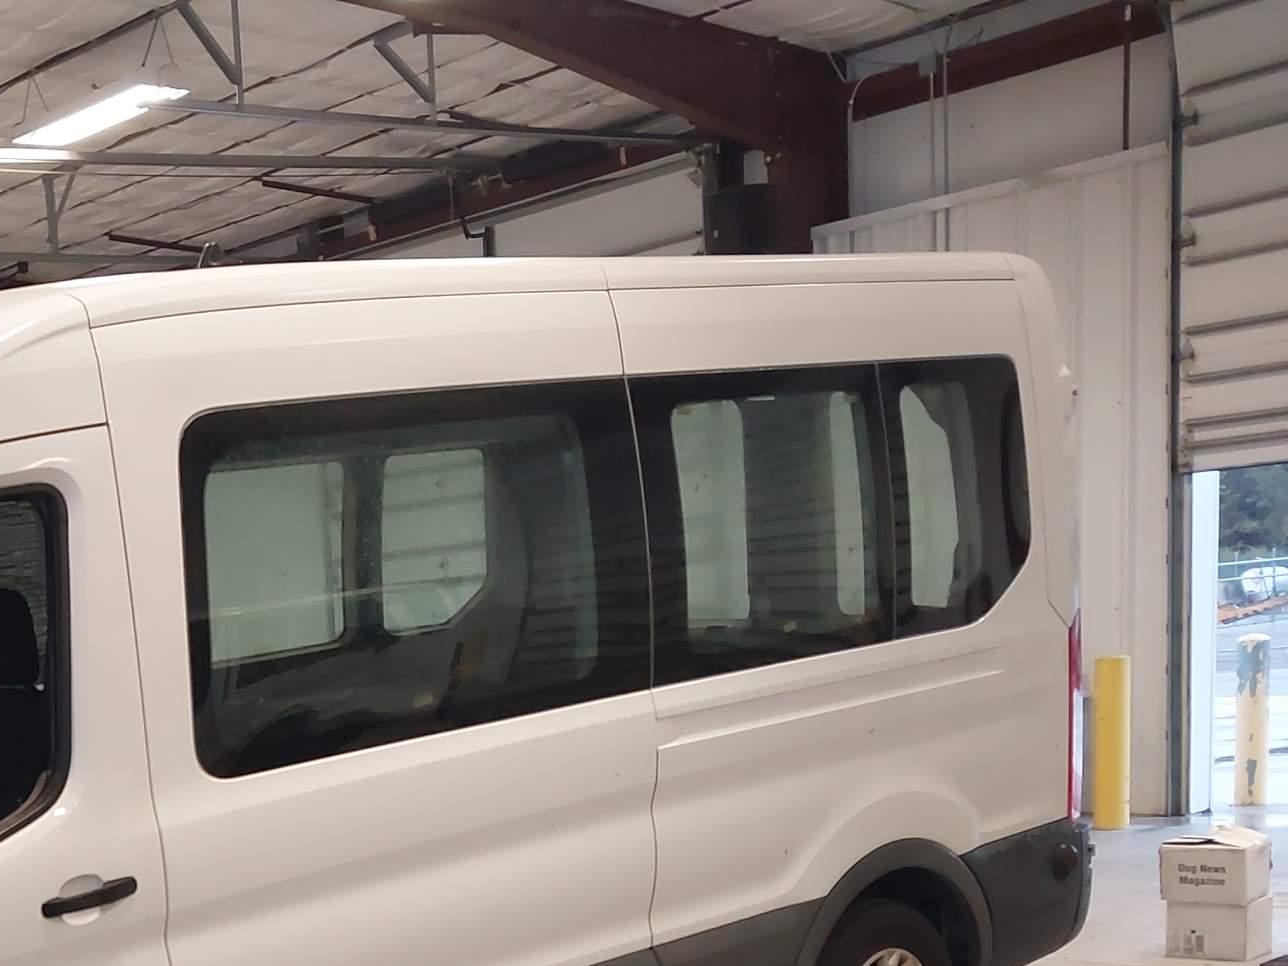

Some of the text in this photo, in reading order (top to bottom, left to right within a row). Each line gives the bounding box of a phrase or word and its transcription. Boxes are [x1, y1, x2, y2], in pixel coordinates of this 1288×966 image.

[1177, 863, 1227, 875] Dog News
[1179, 875, 1227, 887] Magazine
